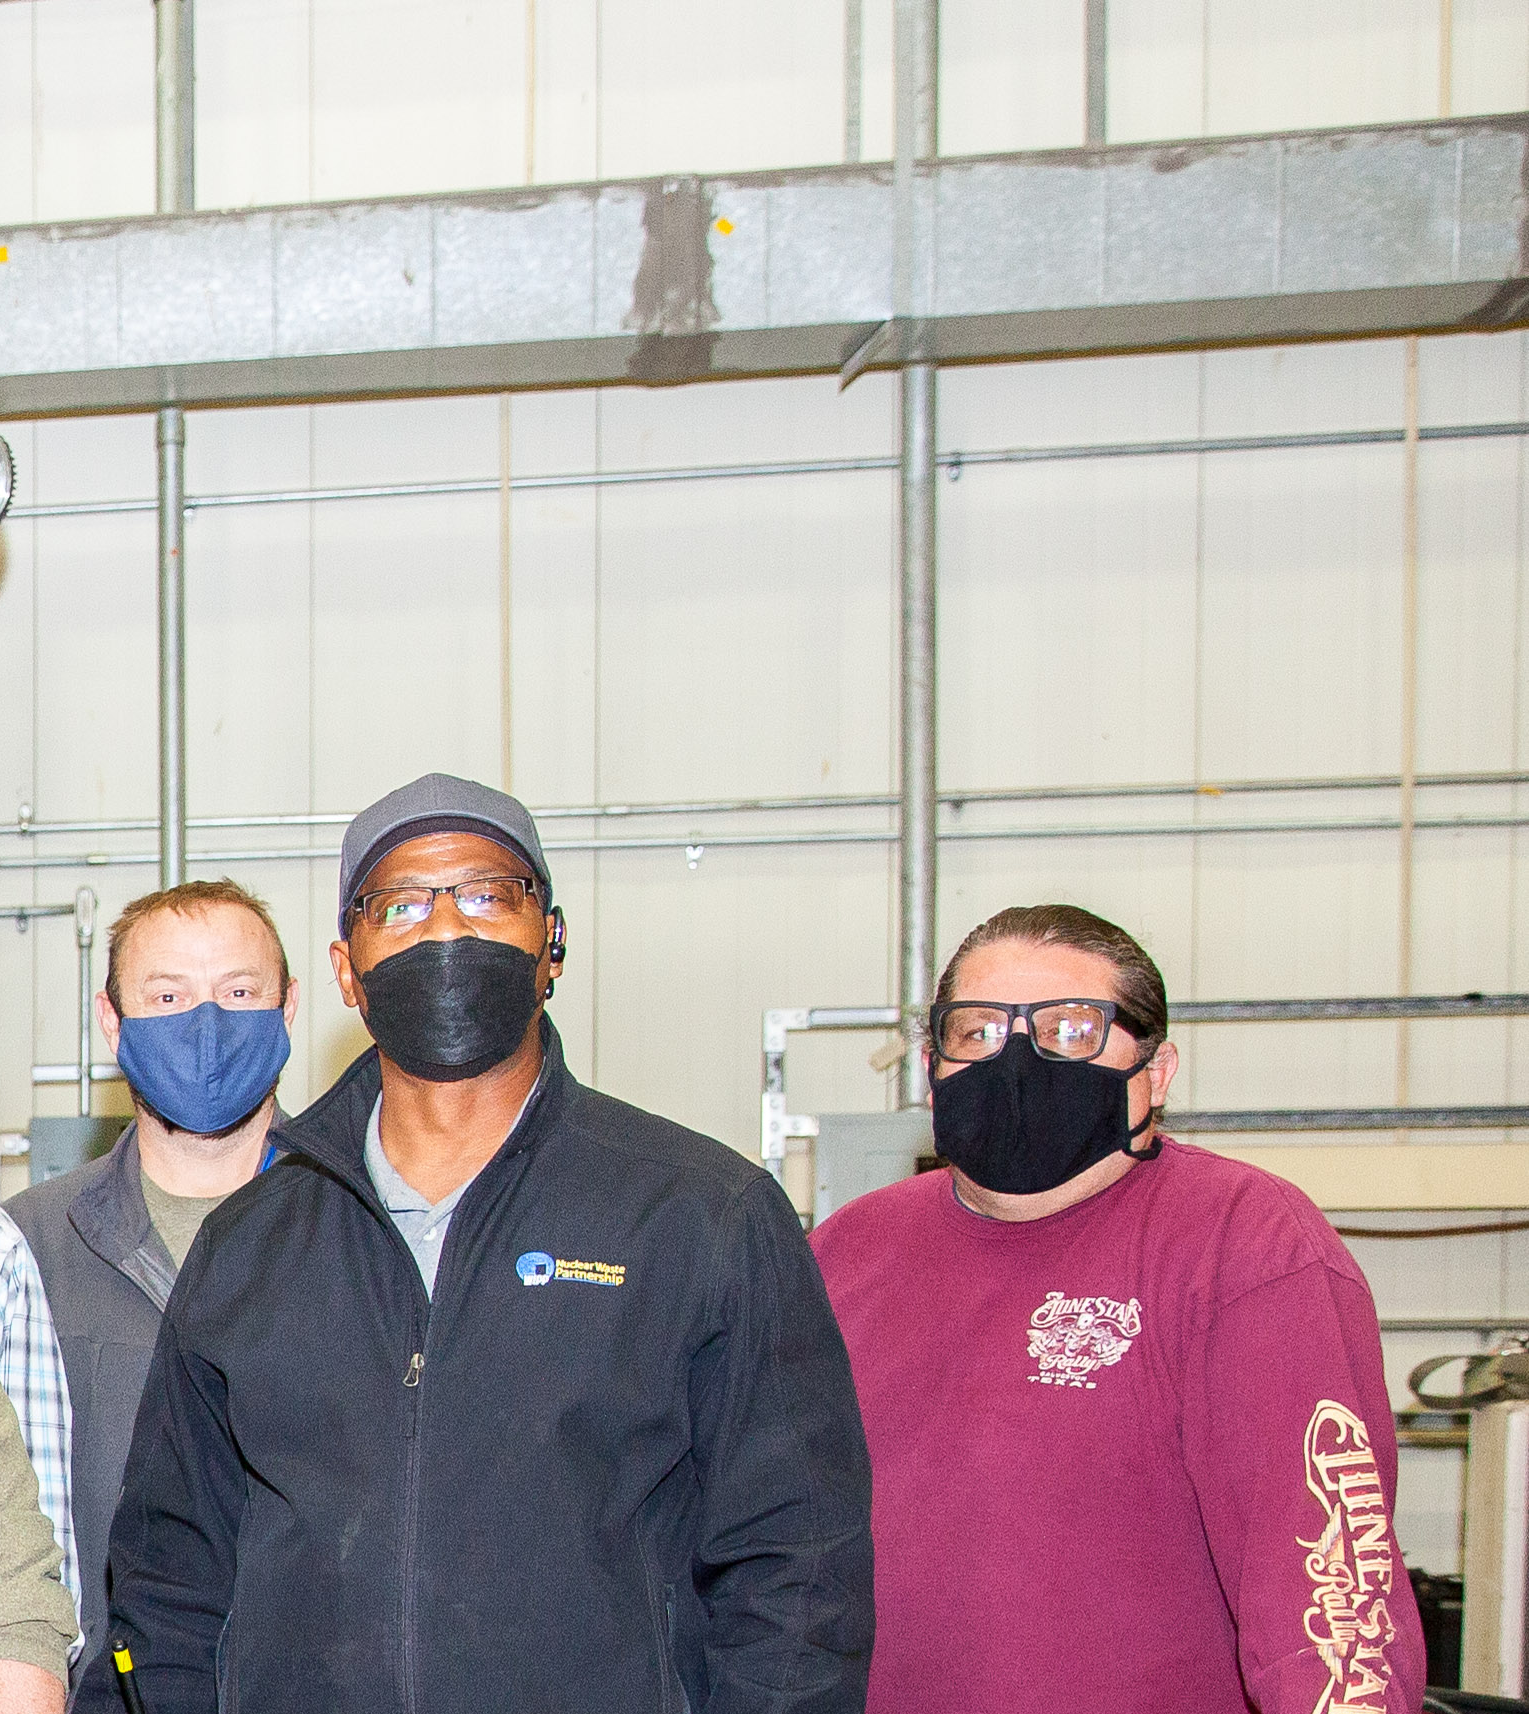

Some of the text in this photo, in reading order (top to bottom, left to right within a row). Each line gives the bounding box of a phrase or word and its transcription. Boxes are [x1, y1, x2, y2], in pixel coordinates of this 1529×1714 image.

[555, 1260, 626, 1275] Nuclear Waste
[555, 1267, 626, 1287] Partnership
[1038, 1353, 1100, 1376] Rally
[1026, 1375, 1098, 1390] TEXAS
[1297, 1534, 1365, 1648] Rally
